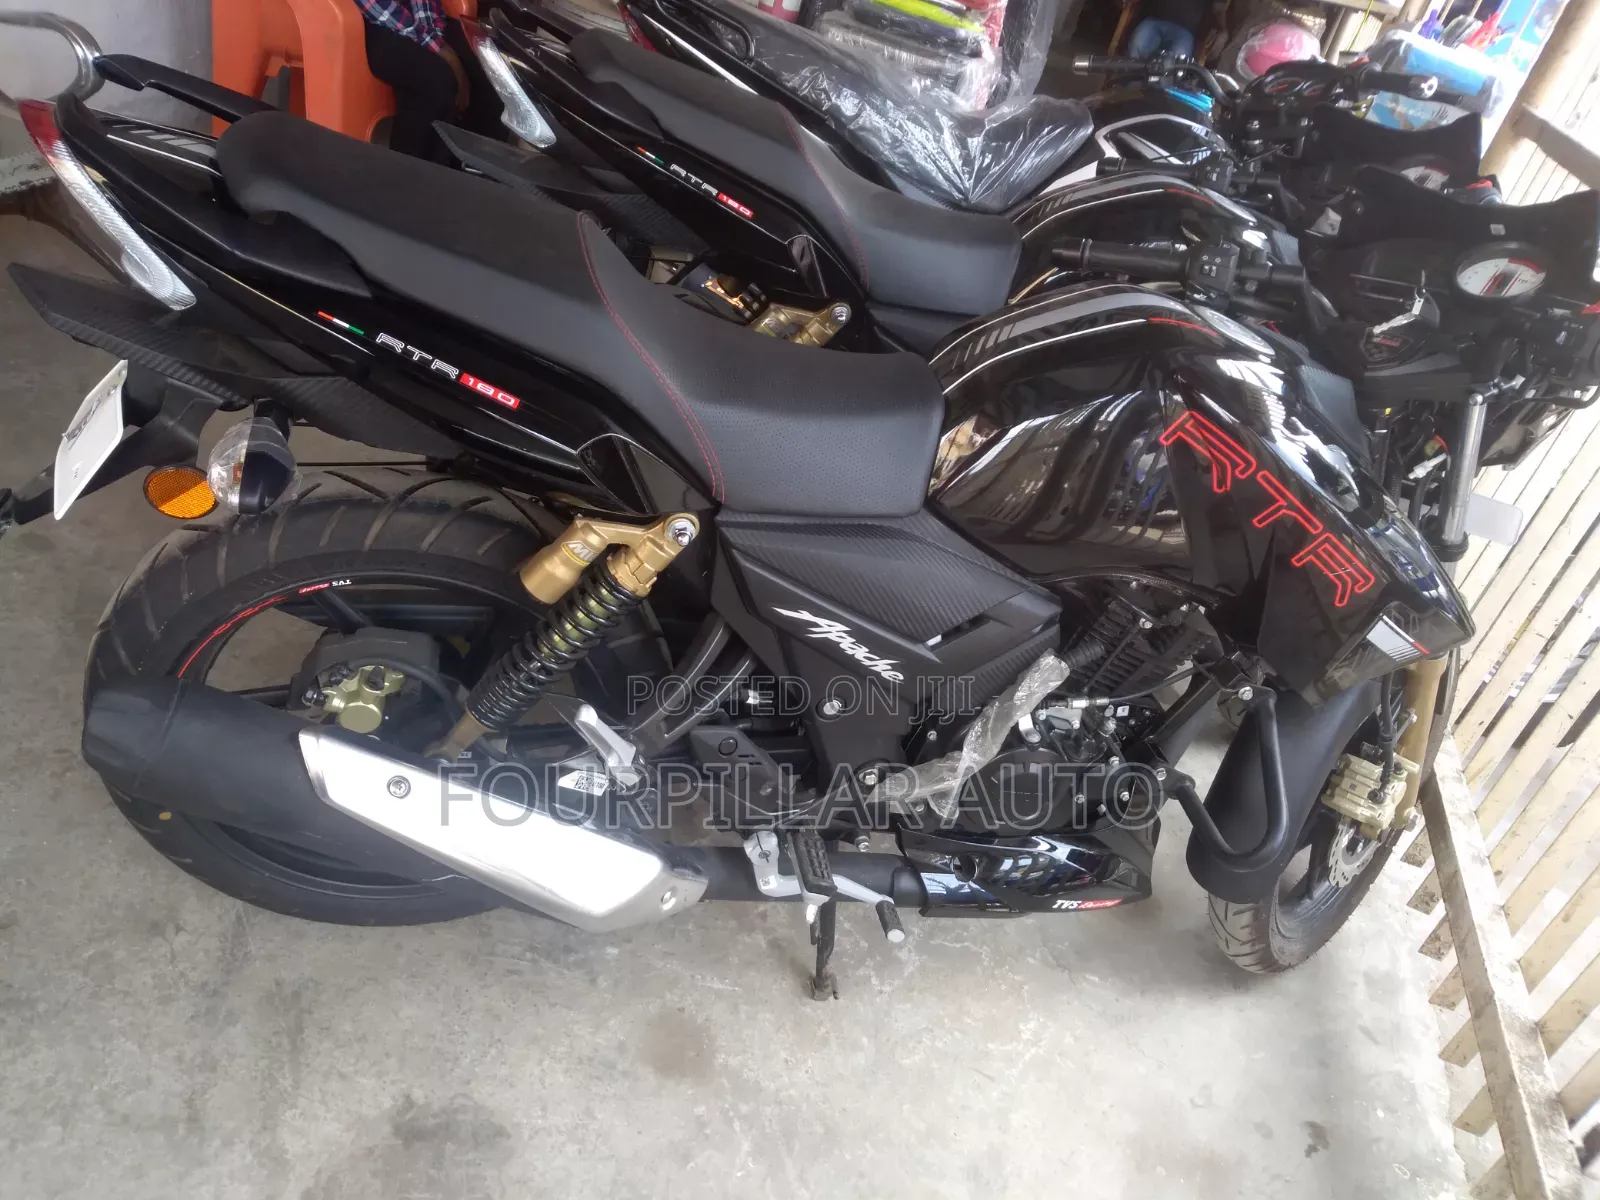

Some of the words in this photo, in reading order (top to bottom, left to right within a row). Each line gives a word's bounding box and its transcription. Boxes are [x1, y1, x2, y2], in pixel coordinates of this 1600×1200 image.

[669, 163, 718, 196] RTR
[375, 332, 460, 379] RTR
[1159, 410, 1376, 607] RTR
[331, 579, 352, 587] TVS
[771, 606, 905, 684] Apache
[1052, 899, 1083, 909] TVS
